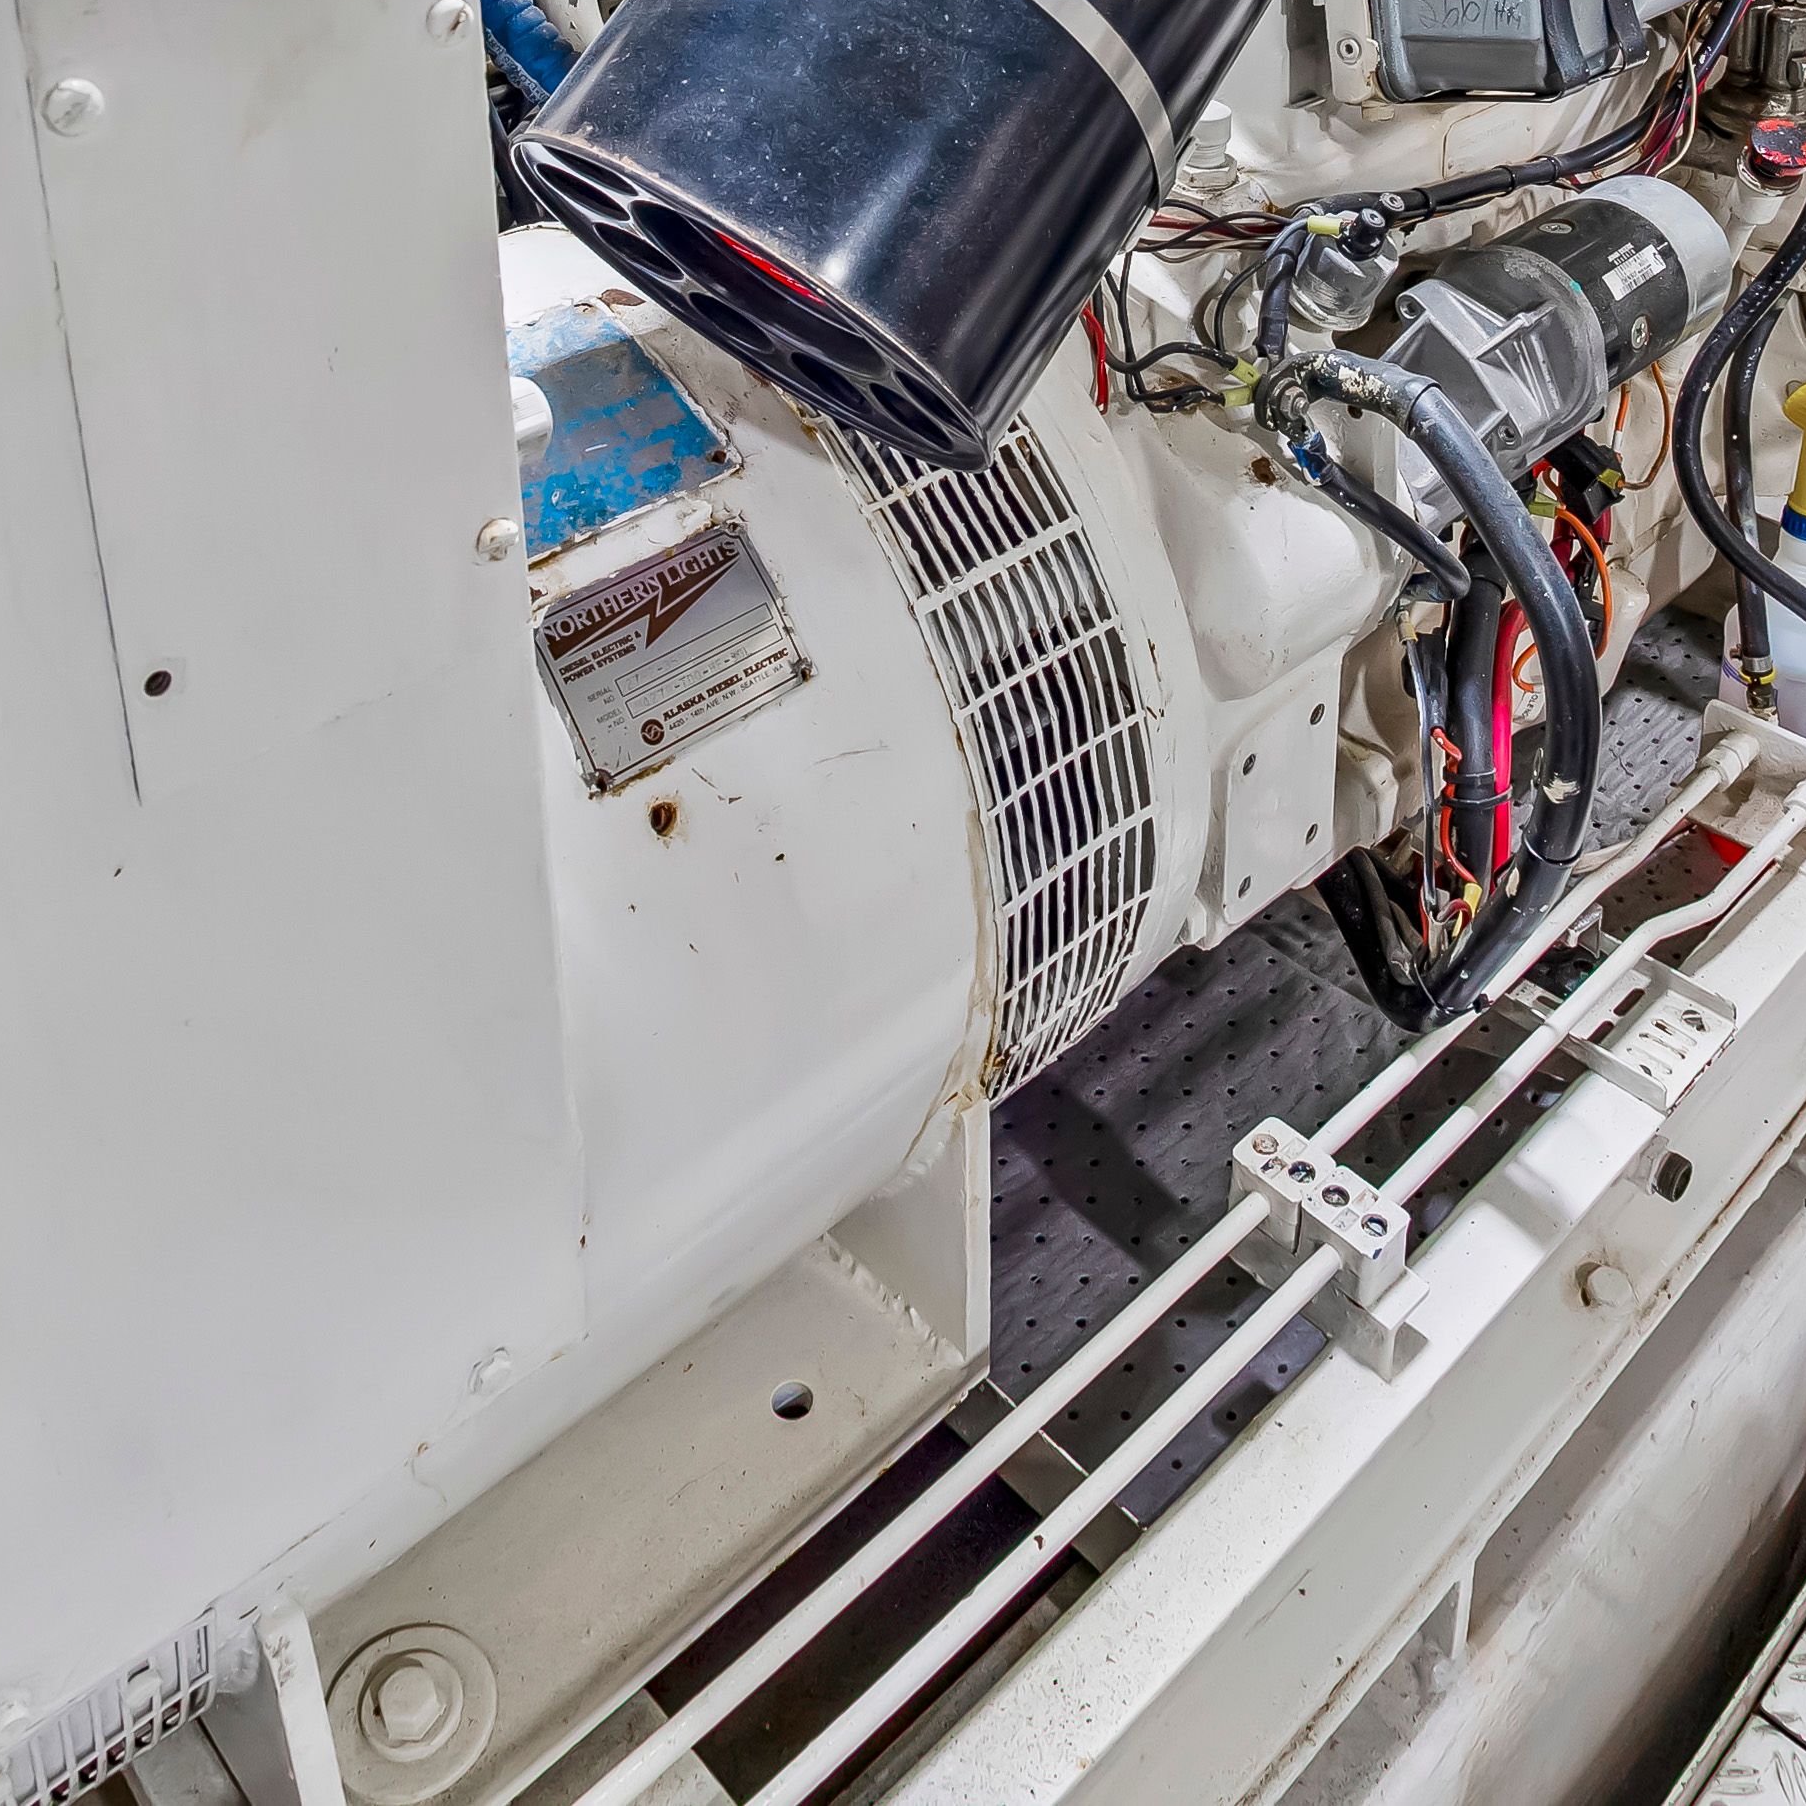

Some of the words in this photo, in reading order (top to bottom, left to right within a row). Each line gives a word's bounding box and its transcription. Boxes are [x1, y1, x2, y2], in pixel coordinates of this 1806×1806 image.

[543, 573, 663, 644] NORTHERN
[665, 540, 740, 586] LIGHTS
[558, 655, 590, 677] DIESEL
[591, 633, 634, 661] ELECTRIC
[562, 663, 596, 685] POWER
[596, 644, 637, 669] SYSTEMS
[772, 663, 785, 674] WA
[661, 692, 706, 721] ALASKA
[706, 673, 743, 699] DIESEL
[743, 647, 790, 678] ELECTRIC
[596, 708, 623, 724] MODEL
